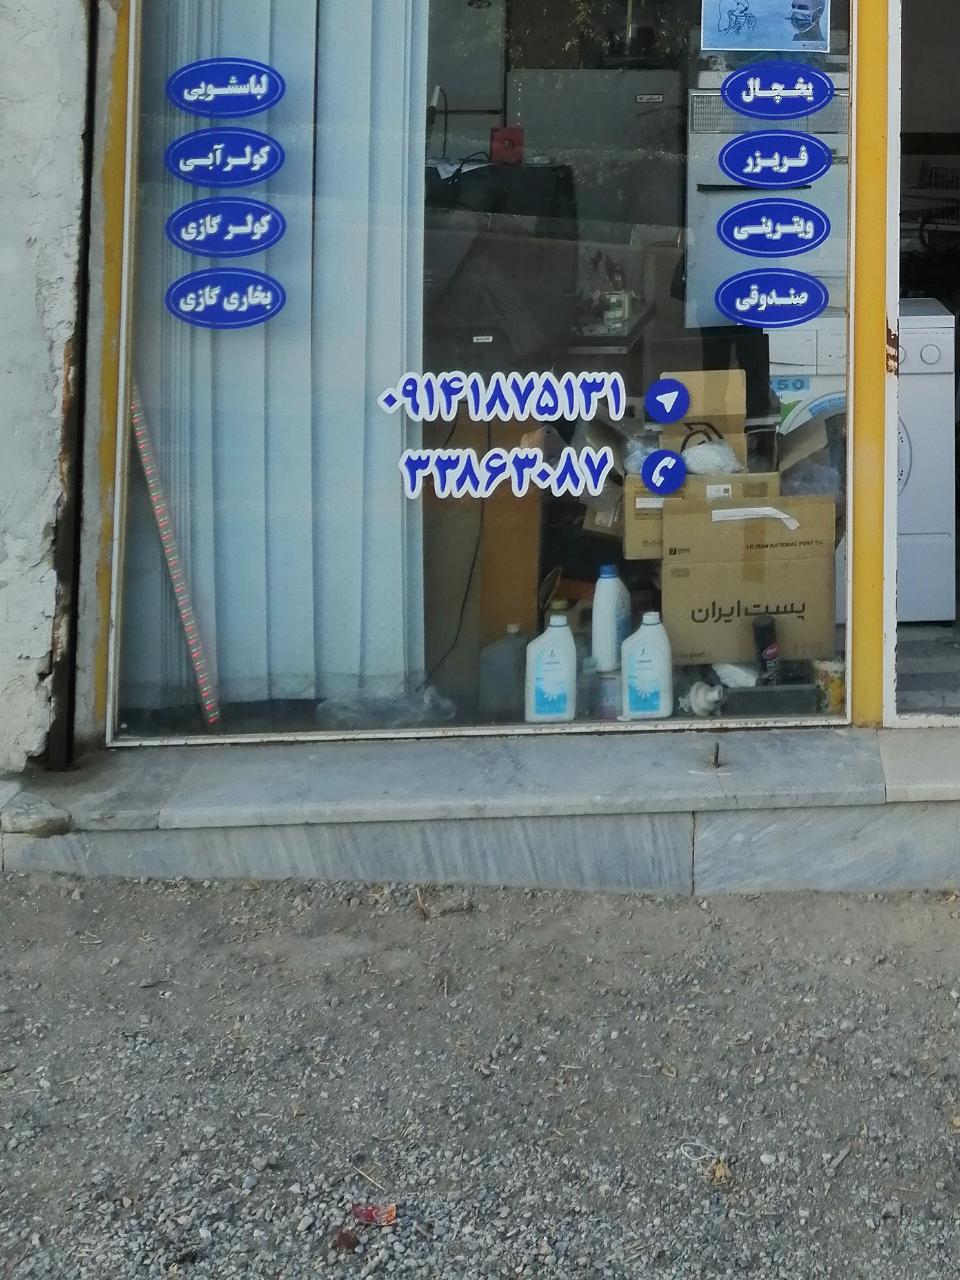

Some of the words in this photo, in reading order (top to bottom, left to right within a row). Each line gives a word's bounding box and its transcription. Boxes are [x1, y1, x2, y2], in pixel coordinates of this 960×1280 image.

[183, 74, 268, 101] لباسشویی
[742, 77, 814, 104] یخچال
[179, 144, 225, 172] آبی
[223, 145, 270, 172] کولر
[743, 145, 808, 174] فریزر
[181, 214, 222, 241] گازی
[224, 214, 272, 241] کولر
[733, 216, 814, 240] ویترینی
[180, 285, 221, 312] گازی
[223, 284, 273, 312] بخاری
[736, 284, 808, 311] صندوقی
[379, 373, 625, 420] ۰۹۱۴۱۸۷۵۱۳۱
[401, 448, 613, 498] ۳۳۸۶۳۰۸۷
[691, 600, 741, 623] ایران
[744, 600, 806, 622] پست
